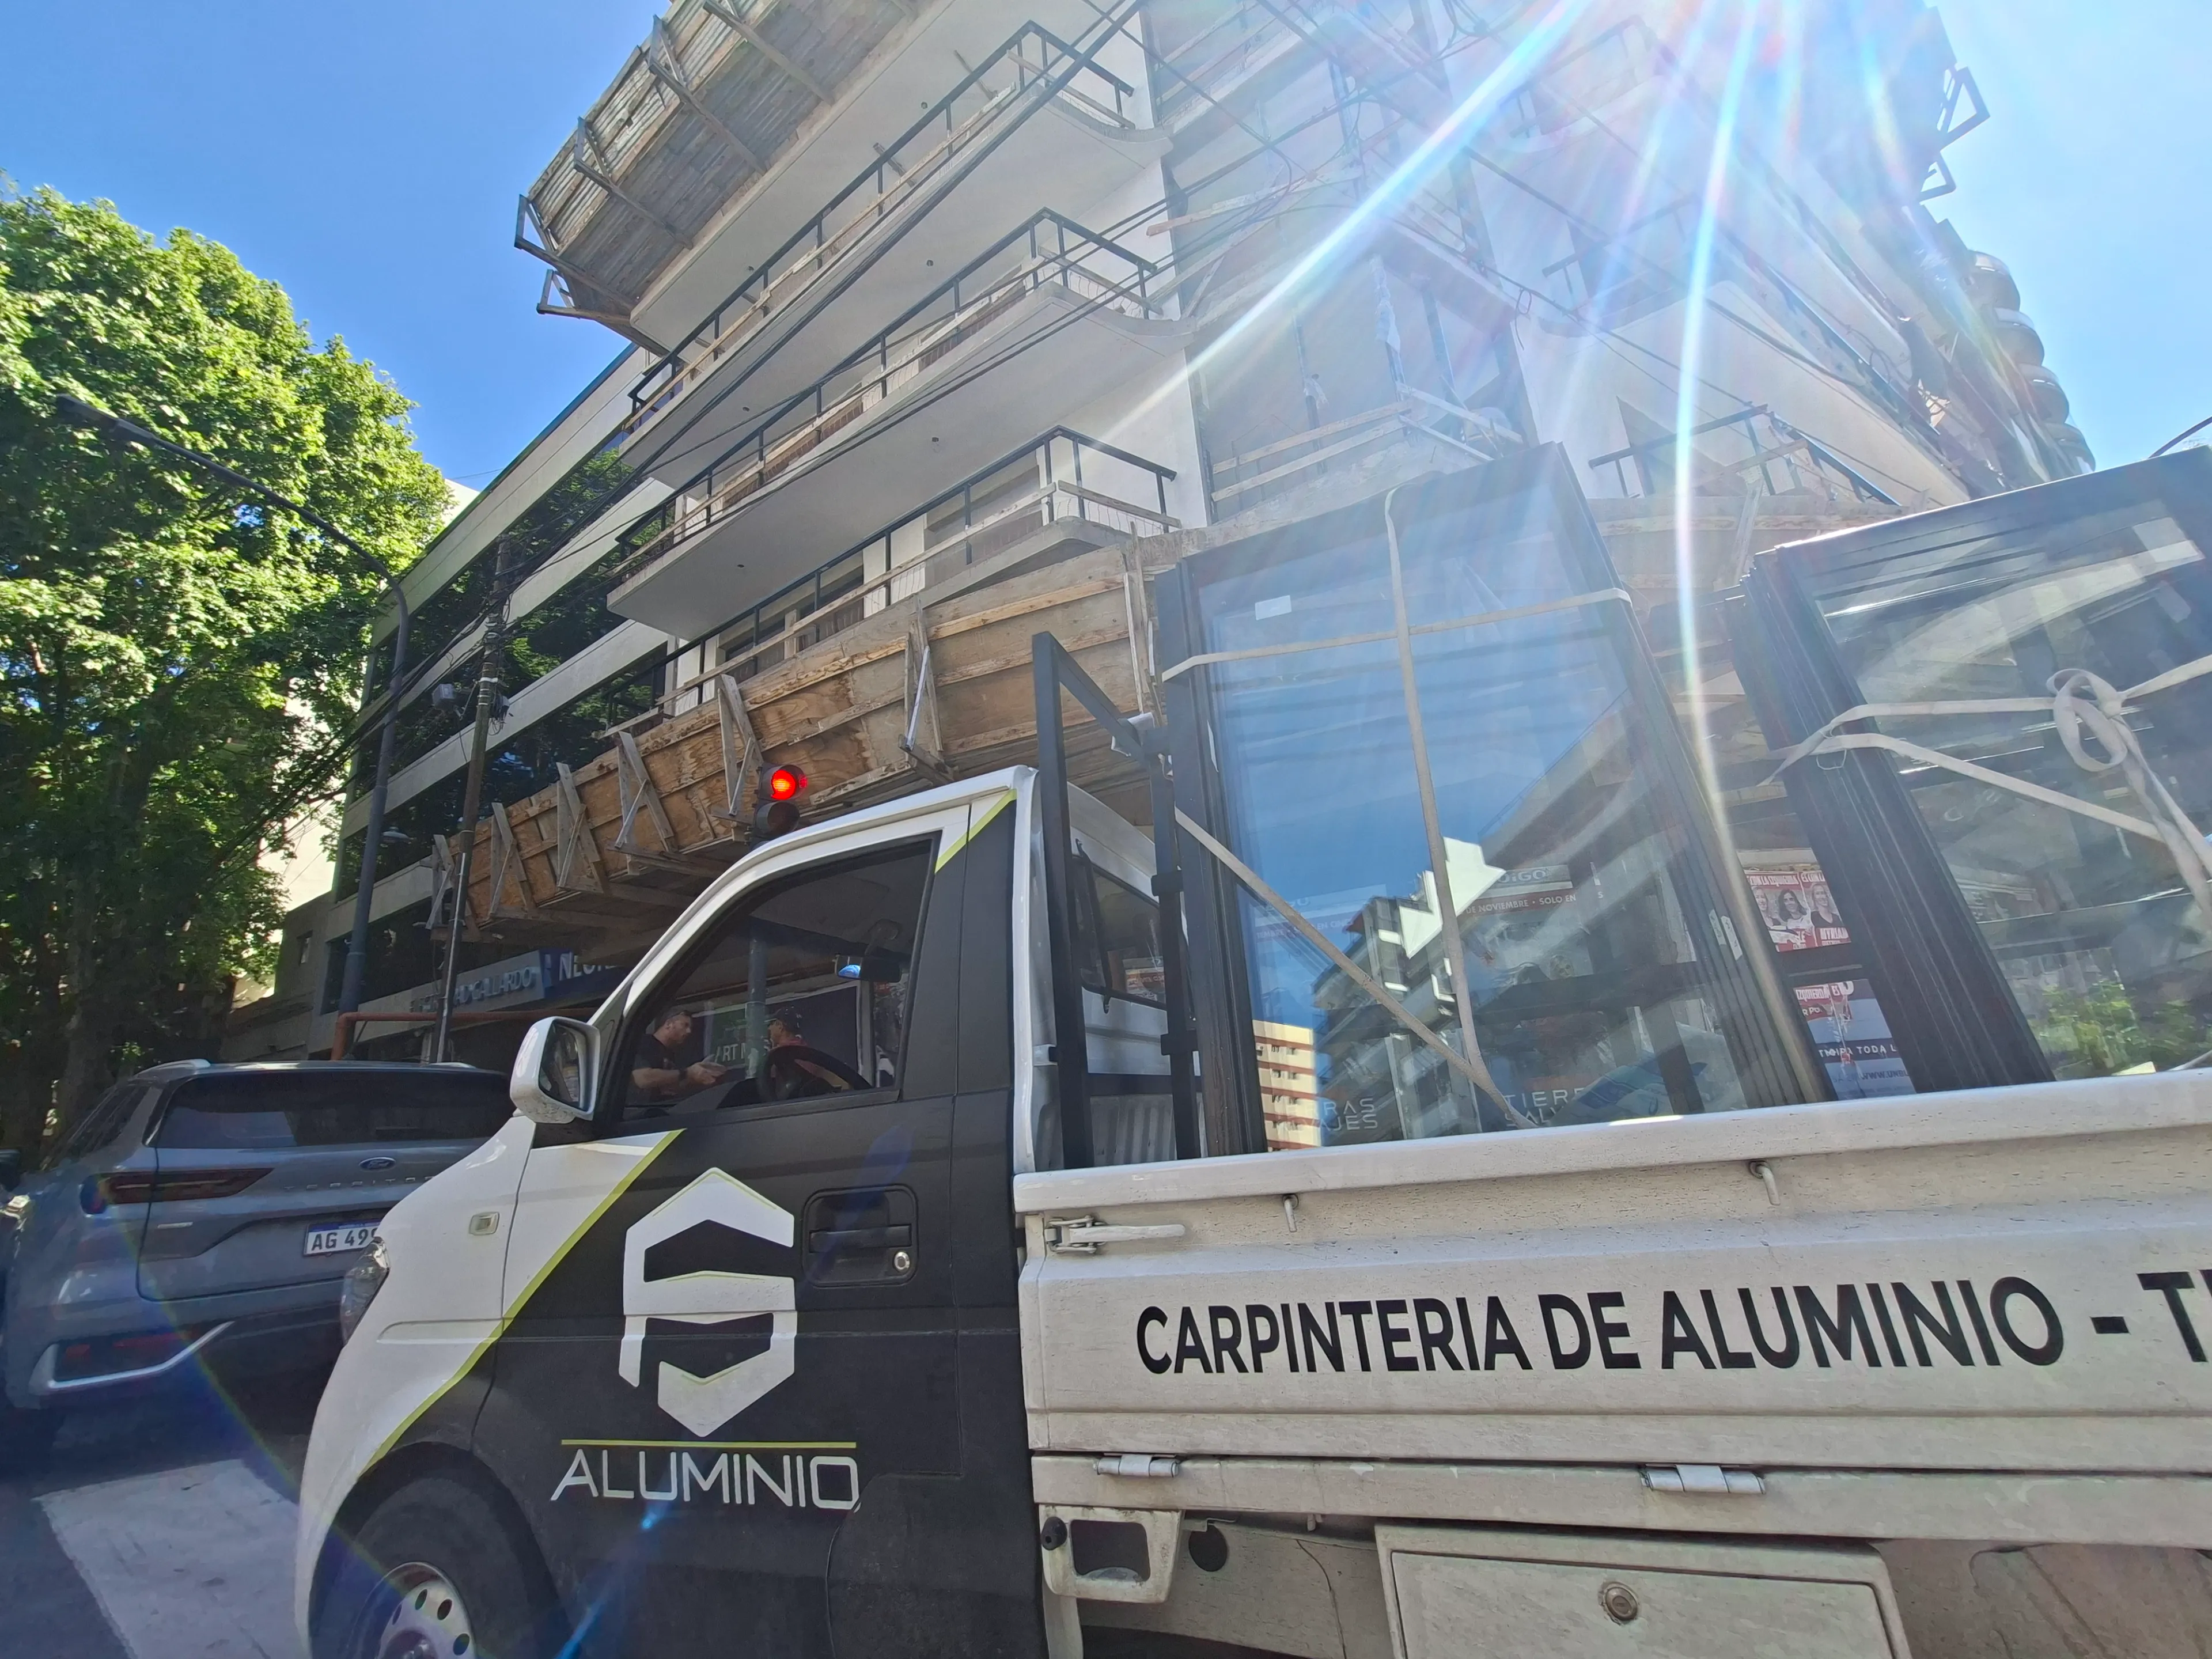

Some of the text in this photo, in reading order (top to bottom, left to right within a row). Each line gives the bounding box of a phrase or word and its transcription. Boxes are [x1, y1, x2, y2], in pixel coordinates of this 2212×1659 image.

[1478, 900, 1529, 912] NOVIEMBRE
[1539, 896, 1563, 906] SOLO
[1565, 893, 1577, 902] EN
[1856, 1044, 1887, 1055] TODA
[311, 1232, 338, 1251] AG
[1136, 1296, 1533, 1374] CARPINTERIA
[1538, 1291, 1642, 1370] DE
[1661, 1276, 2065, 1369] ALUMINIO
[2137, 1268, 2212, 1363] T
[551, 1449, 861, 1513] ALUMINIO
